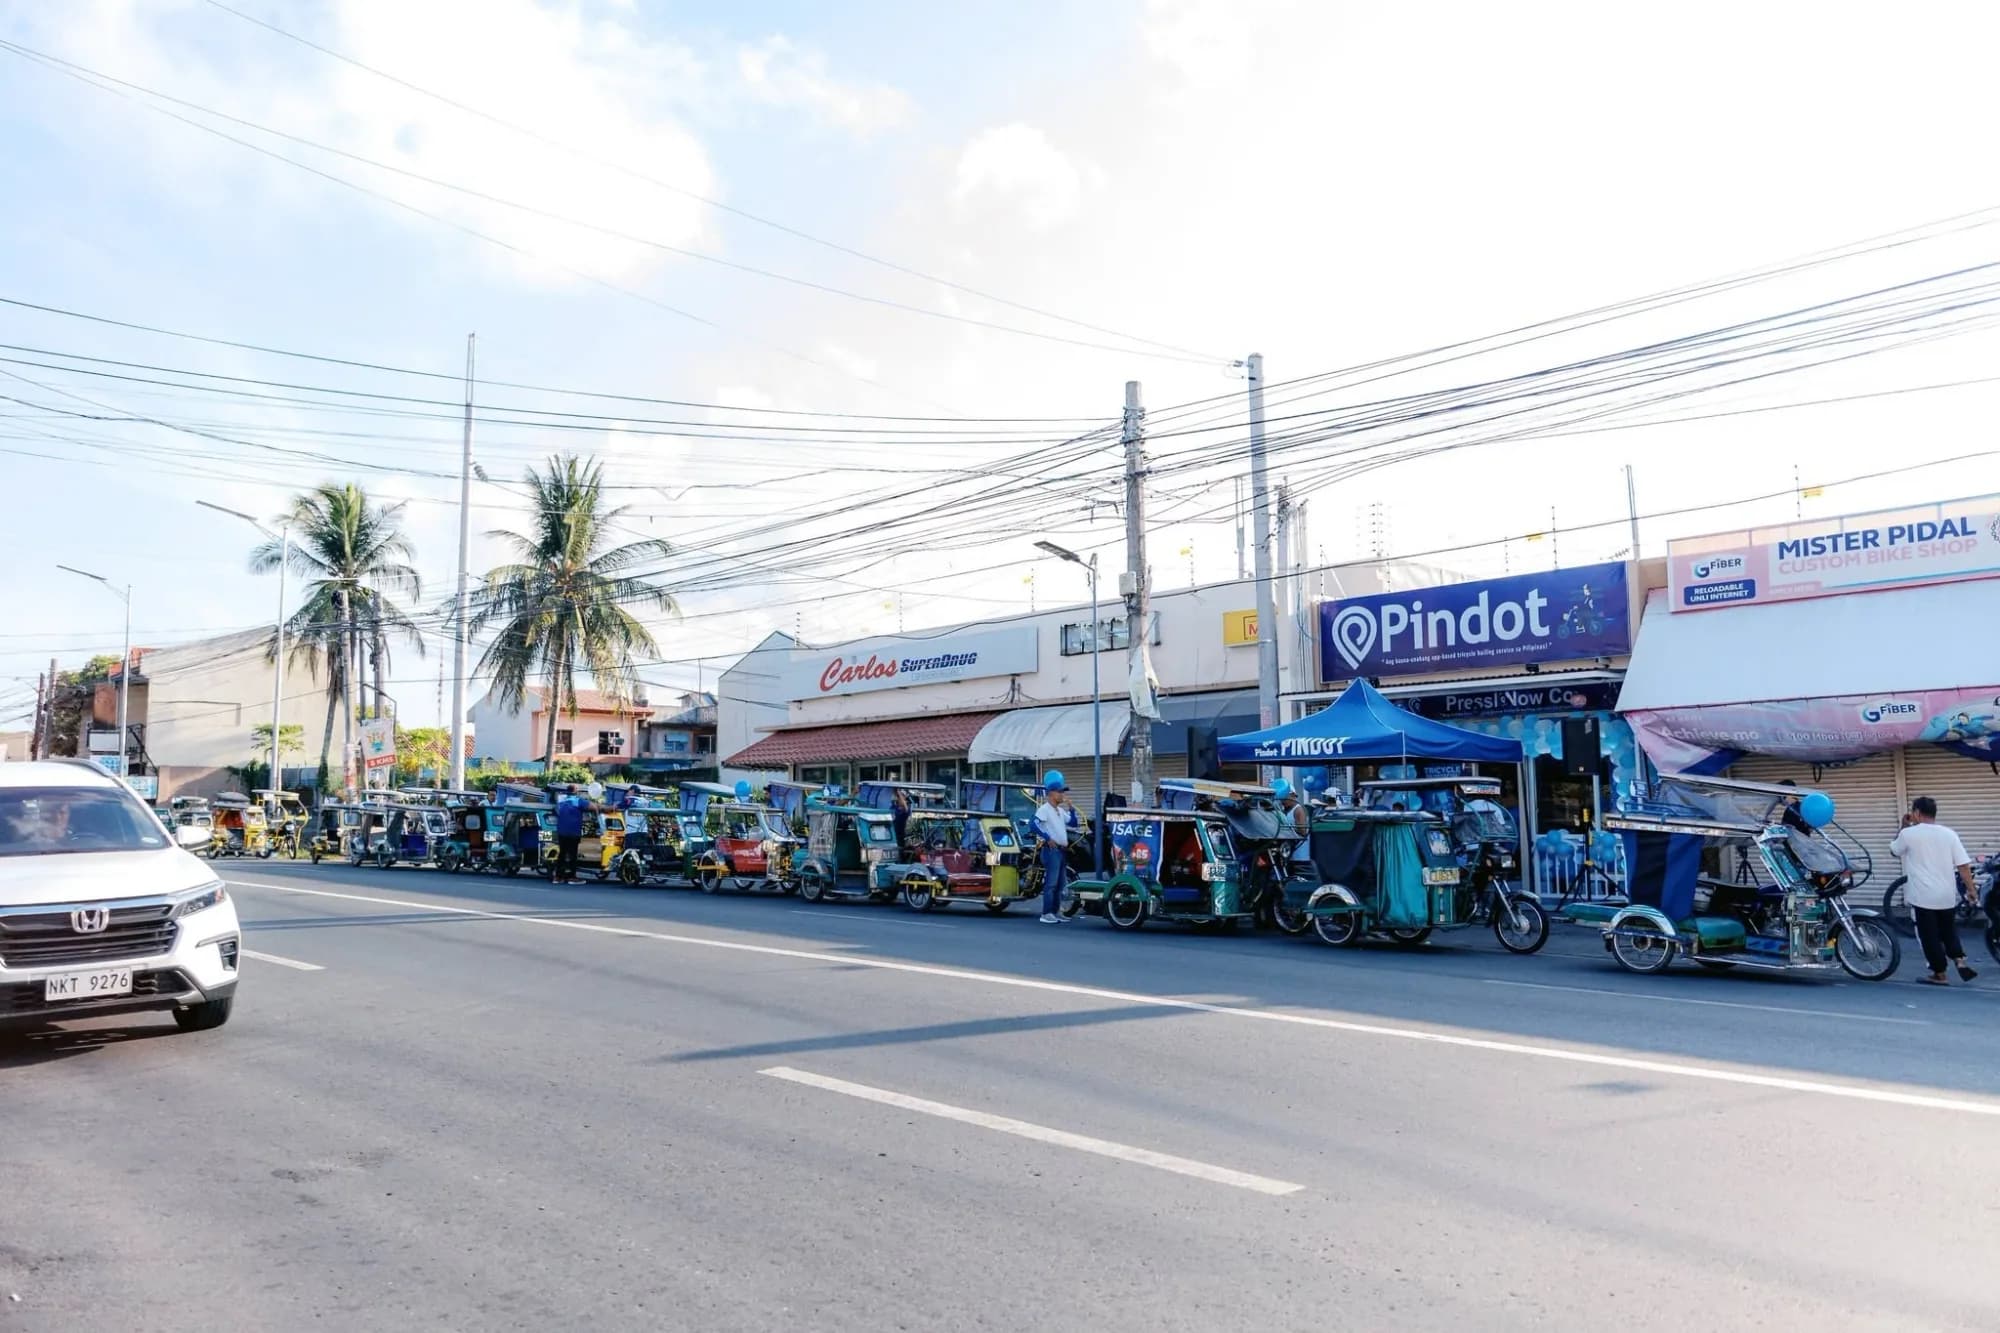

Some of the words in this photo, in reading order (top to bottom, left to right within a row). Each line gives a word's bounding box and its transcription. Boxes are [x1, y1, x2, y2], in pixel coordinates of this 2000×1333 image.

[1778, 529, 1880, 560] MISTER
[1888, 517, 1976, 545] PIDAL
[1778, 551, 1860, 575] CUSTOM
[1867, 546, 1912, 565] BIKE
[1919, 538, 1978, 558] SHOP
[1690, 593, 1709, 602] UNLI
[1710, 590, 1749, 600] INTERNET
[1694, 583, 1744, 594] RELOADABLE
[1381, 589, 1550, 653] Pindot
[819, 655, 899, 692] Carlos
[1281, 736, 1351, 756] PINDOT
[1424, 766, 1460, 774] TRICYCLE
[48, 977, 78, 994] NKT
[90, 972, 128, 991] 9276
